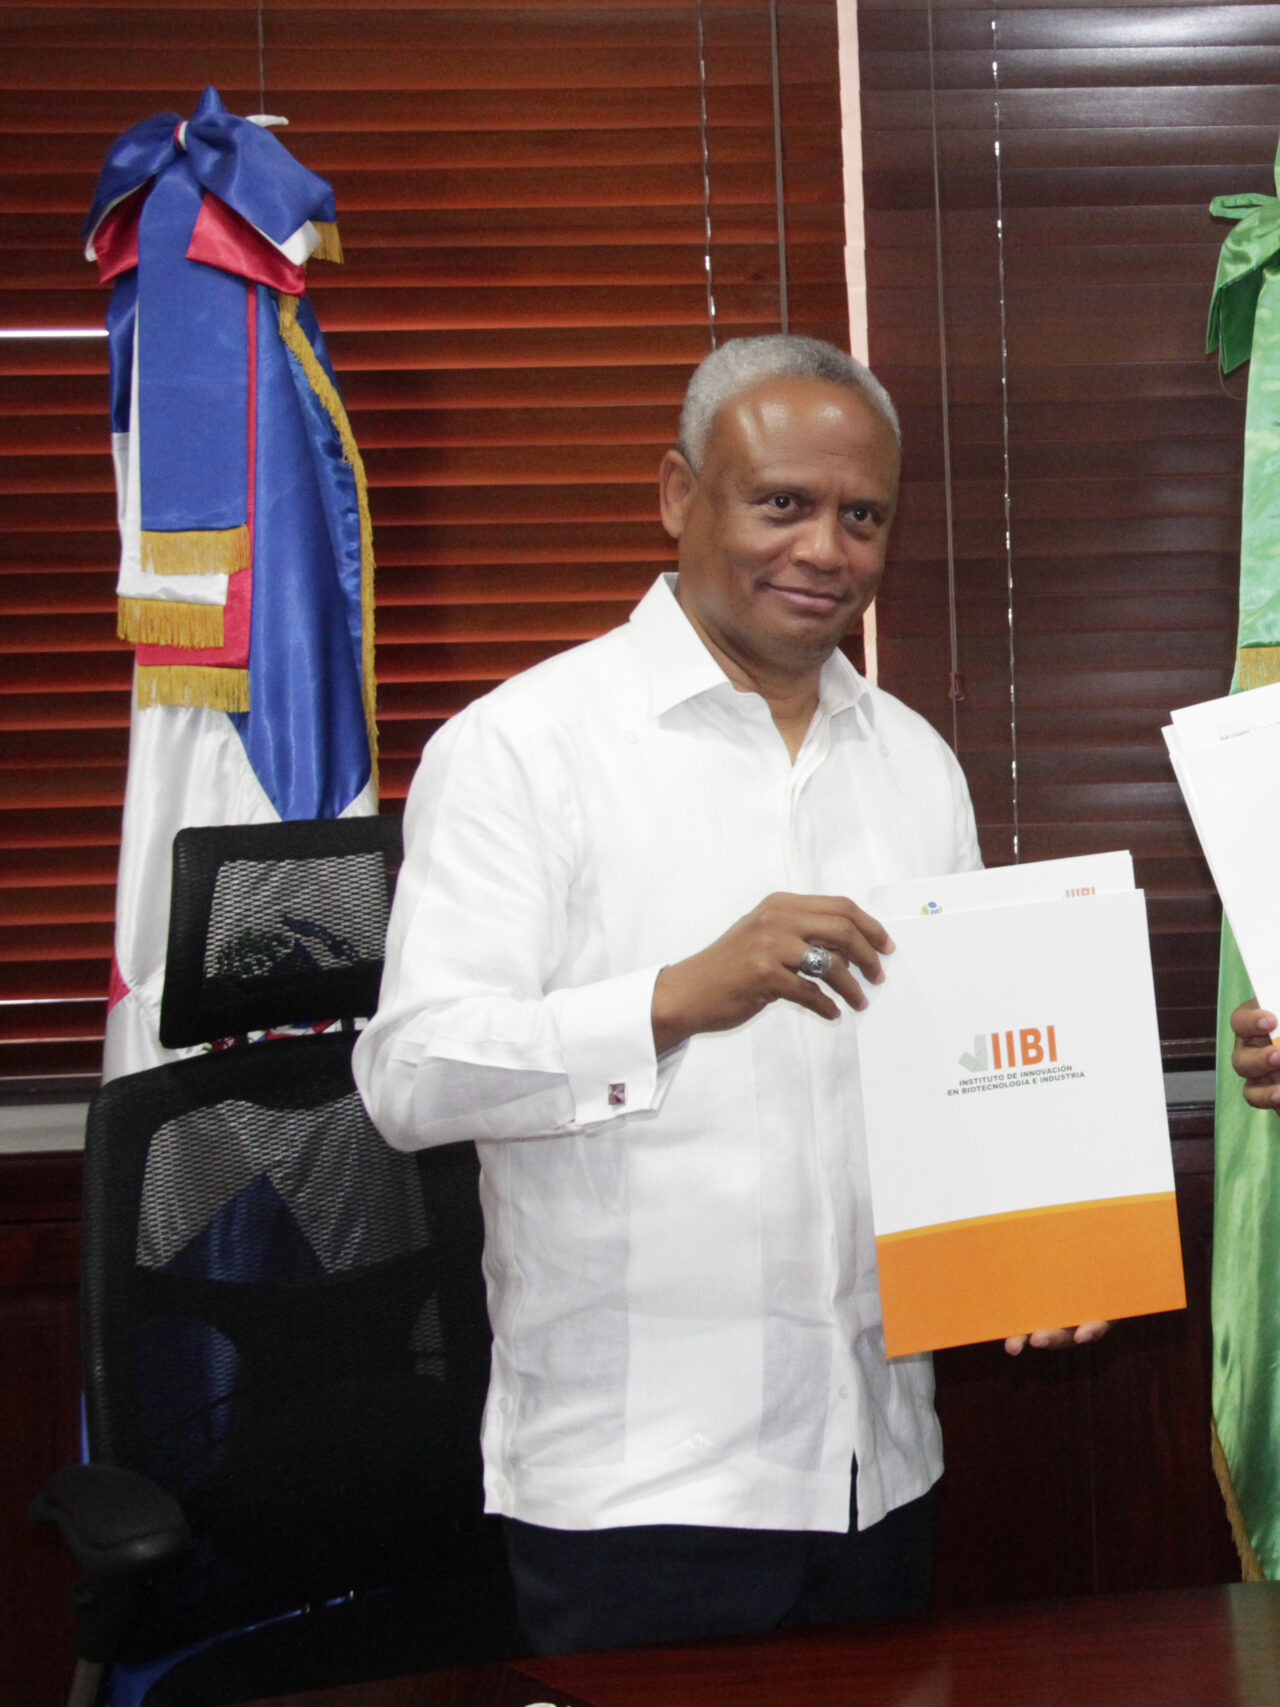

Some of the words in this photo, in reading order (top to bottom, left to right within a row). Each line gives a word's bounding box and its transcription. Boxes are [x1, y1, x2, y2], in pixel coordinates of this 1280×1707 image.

[991, 1025, 1058, 1070] IIBI
[959, 1074, 1005, 1087] INSTITUTO
[1007, 1072, 1018, 1080] DE
[1020, 1065, 1073, 1078] INNOVACIÓN
[1040, 1071, 1085, 1083] INDUSTRIA
